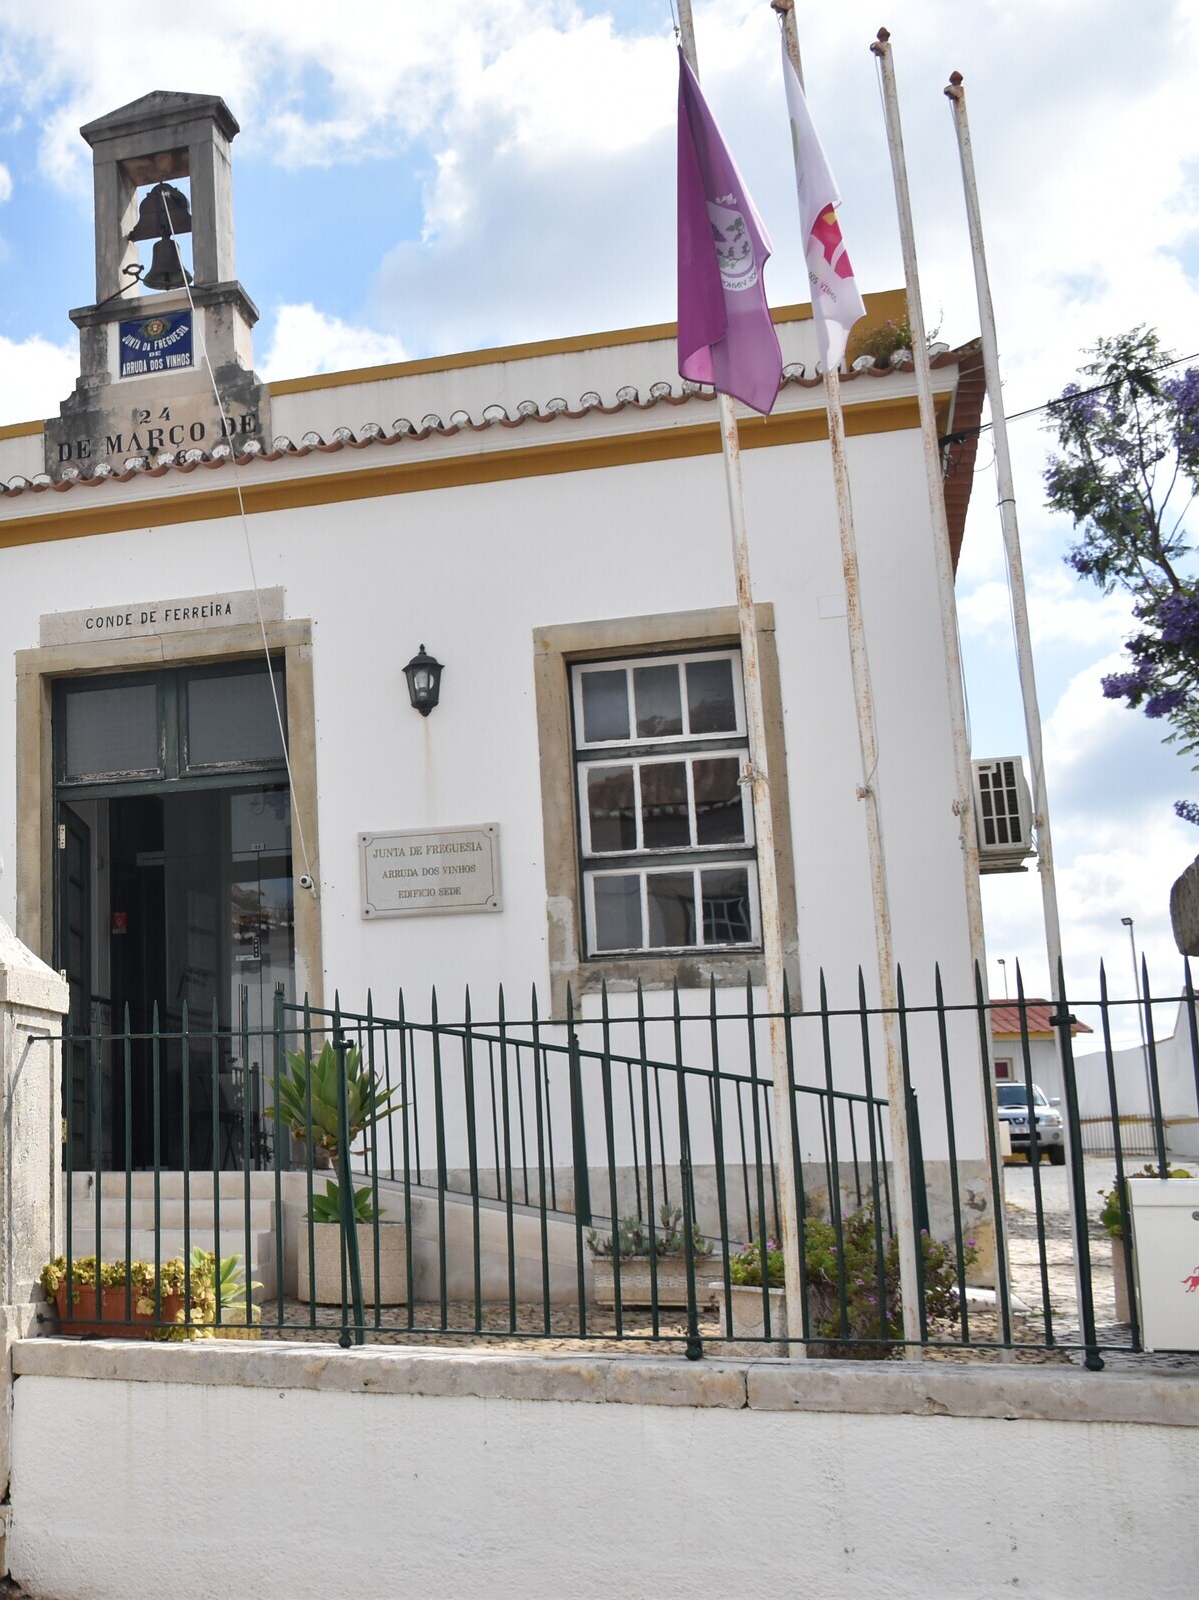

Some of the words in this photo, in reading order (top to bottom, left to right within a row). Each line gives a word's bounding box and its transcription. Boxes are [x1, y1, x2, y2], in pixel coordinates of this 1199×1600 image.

[122, 334, 141, 350] JUNTA
[154, 325, 189, 350] FREGUESIA
[122, 359, 148, 376] ARRUDA
[150, 358, 164, 371] DOS
[165, 353, 190, 368] VINHOS
[139, 406, 171, 425] 24
[58, 439, 92, 463] DE
[105, 422, 206, 456] MARÇO
[221, 414, 257, 438] DE
[86, 613, 133, 630] CONDE
[141, 610, 157, 625] DE
[165, 602, 232, 621] FERREIRA
[373, 847, 406, 859] JUNTA
[409, 847, 423, 856] DE
[426, 842, 482, 855] FREGUESIA
[382, 868, 419, 879] ARRUDA
[422, 867, 440, 876] DOS
[442, 864, 477, 876] VINHOS
[438, 886, 462, 897] SEDE
